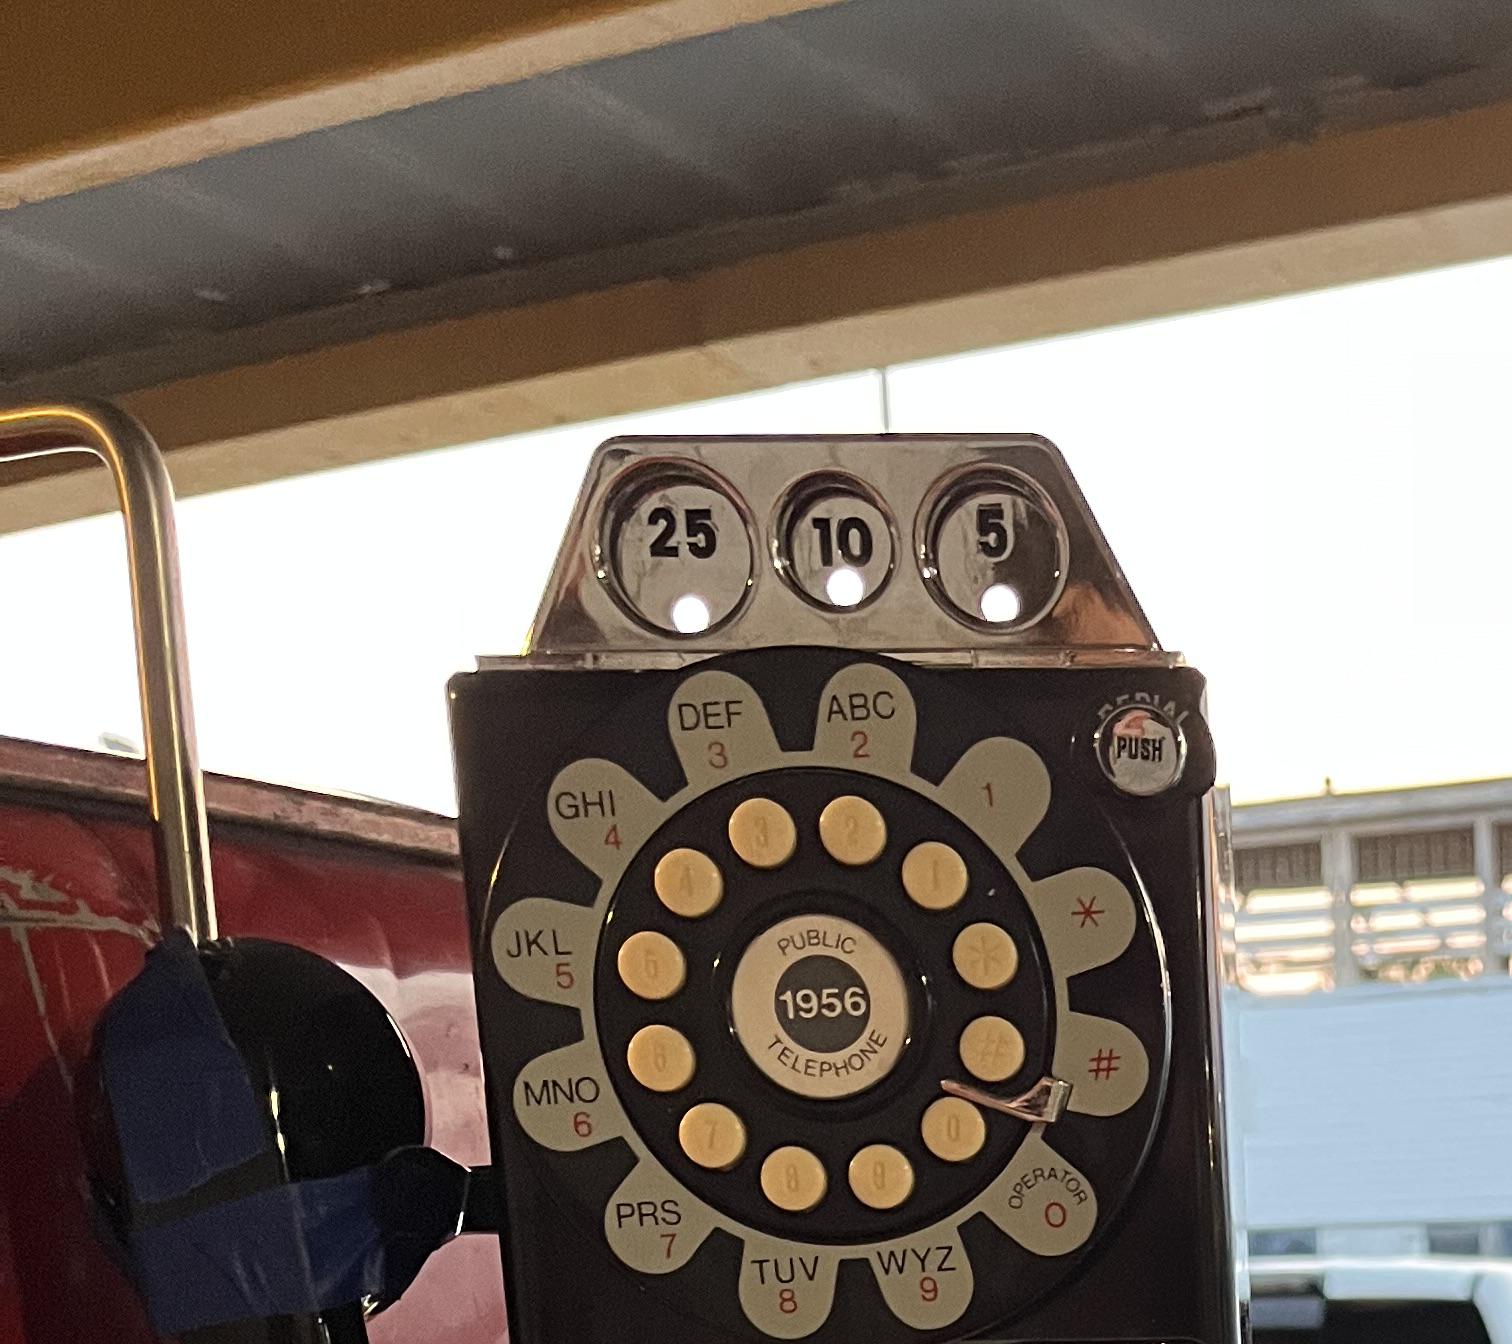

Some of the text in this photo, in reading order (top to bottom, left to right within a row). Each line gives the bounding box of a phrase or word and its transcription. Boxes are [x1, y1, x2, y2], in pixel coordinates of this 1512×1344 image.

[648, 508, 716, 560] 25
[811, 516, 872, 568] 10
[976, 502, 1010, 559] 5
[678, 700, 744, 732] DEF
[825, 691, 898, 724] ABC
[708, 741, 729, 770] 3
[850, 731, 872, 760] 2
[1116, 735, 1163, 762] PUSH
[554, 790, 618, 821] GHI
[980, 782, 996, 808] 1
[602, 825, 622, 851] 4
[505, 930, 574, 959] JKL
[776, 930, 858, 958] PUBLIC
[555, 962, 575, 990] 5
[778, 986, 869, 1020] 1956
[765, 1028, 889, 1079] TELEPHONE
[522, 1076, 601, 1108] MNO
[574, 1111, 592, 1139] 6
[1006, 1166, 1089, 1211] OPERATOR
[615, 1199, 682, 1230] PRS
[659, 1232, 678, 1260] 7
[876, 1246, 958, 1276] WYZ
[750, 1256, 820, 1286] TUV
[779, 1289, 799, 1315] 8
[920, 1276, 939, 1304] 9
